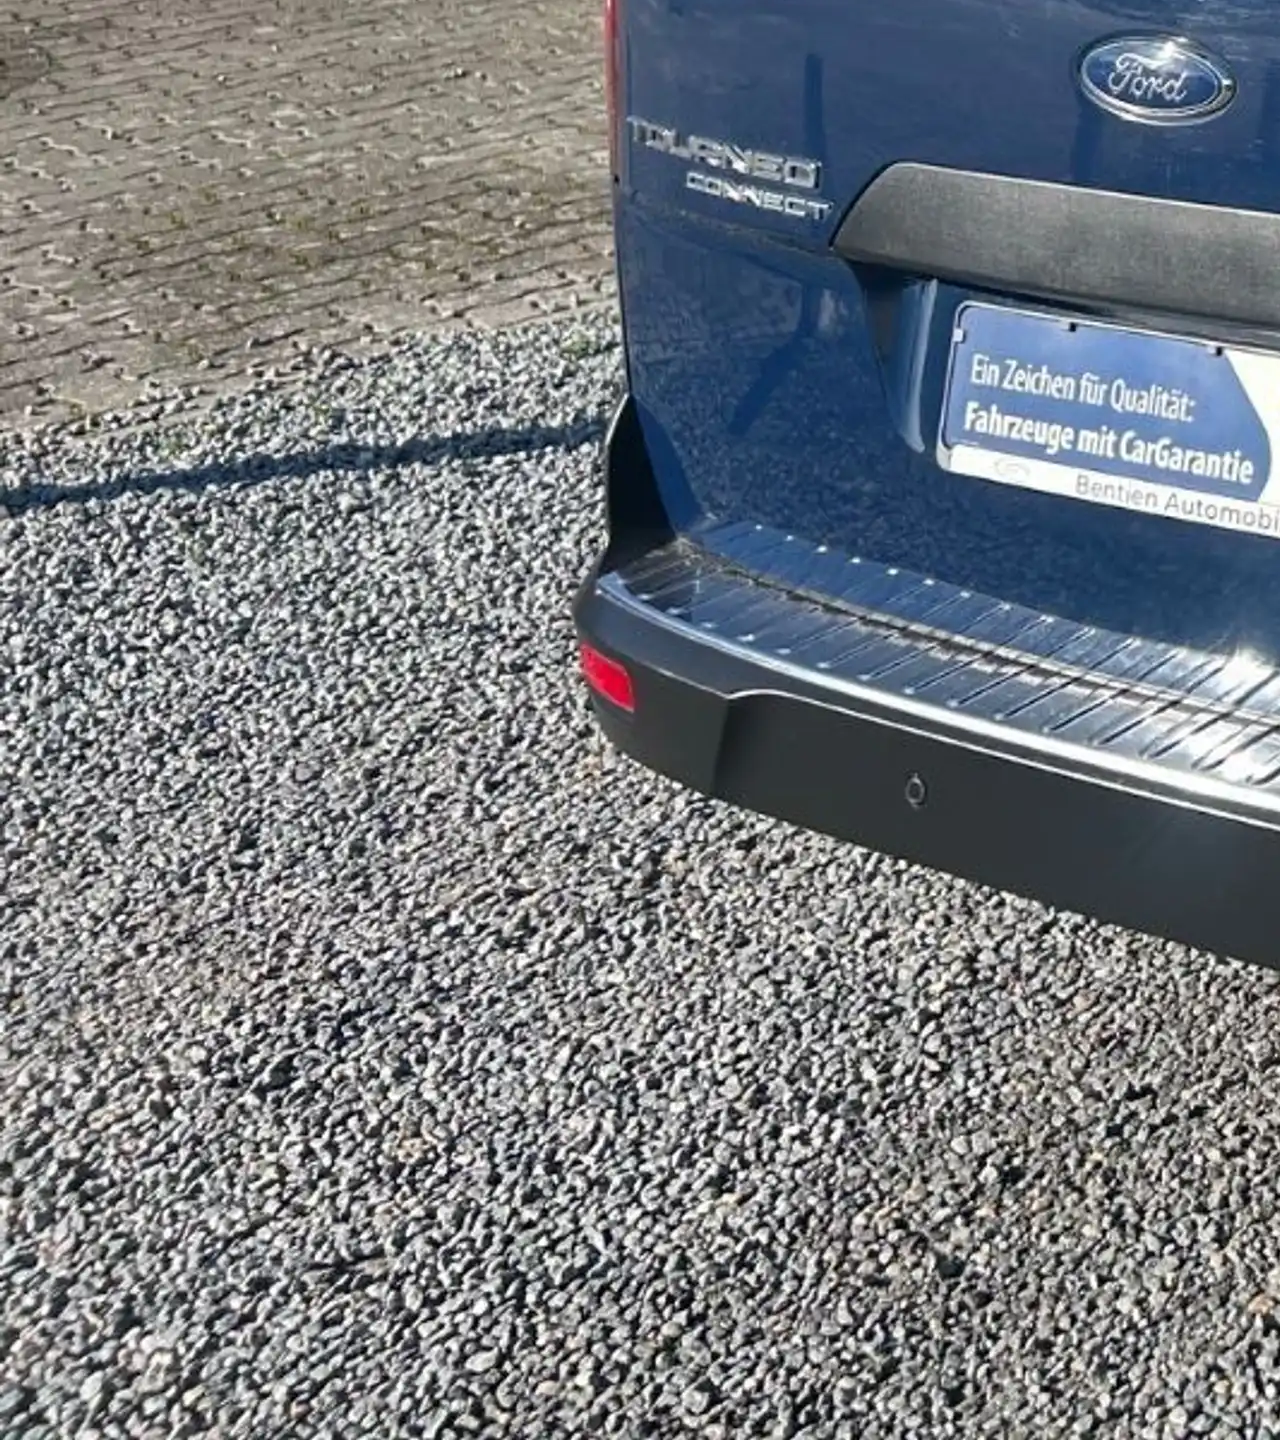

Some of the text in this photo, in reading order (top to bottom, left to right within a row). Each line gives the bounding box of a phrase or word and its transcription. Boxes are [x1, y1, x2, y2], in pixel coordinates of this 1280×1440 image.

[1108, 52, 1188, 102] Ford
[626, 115, 822, 189] TOURNEO
[686, 171, 834, 220] CONNECT
[971, 353, 1197, 423] Ein Zeichen für Qualität:
[964, 401, 1255, 485] Fahrzeuge mit CarGarantie
[1075, 474, 1159, 509] Bentien
